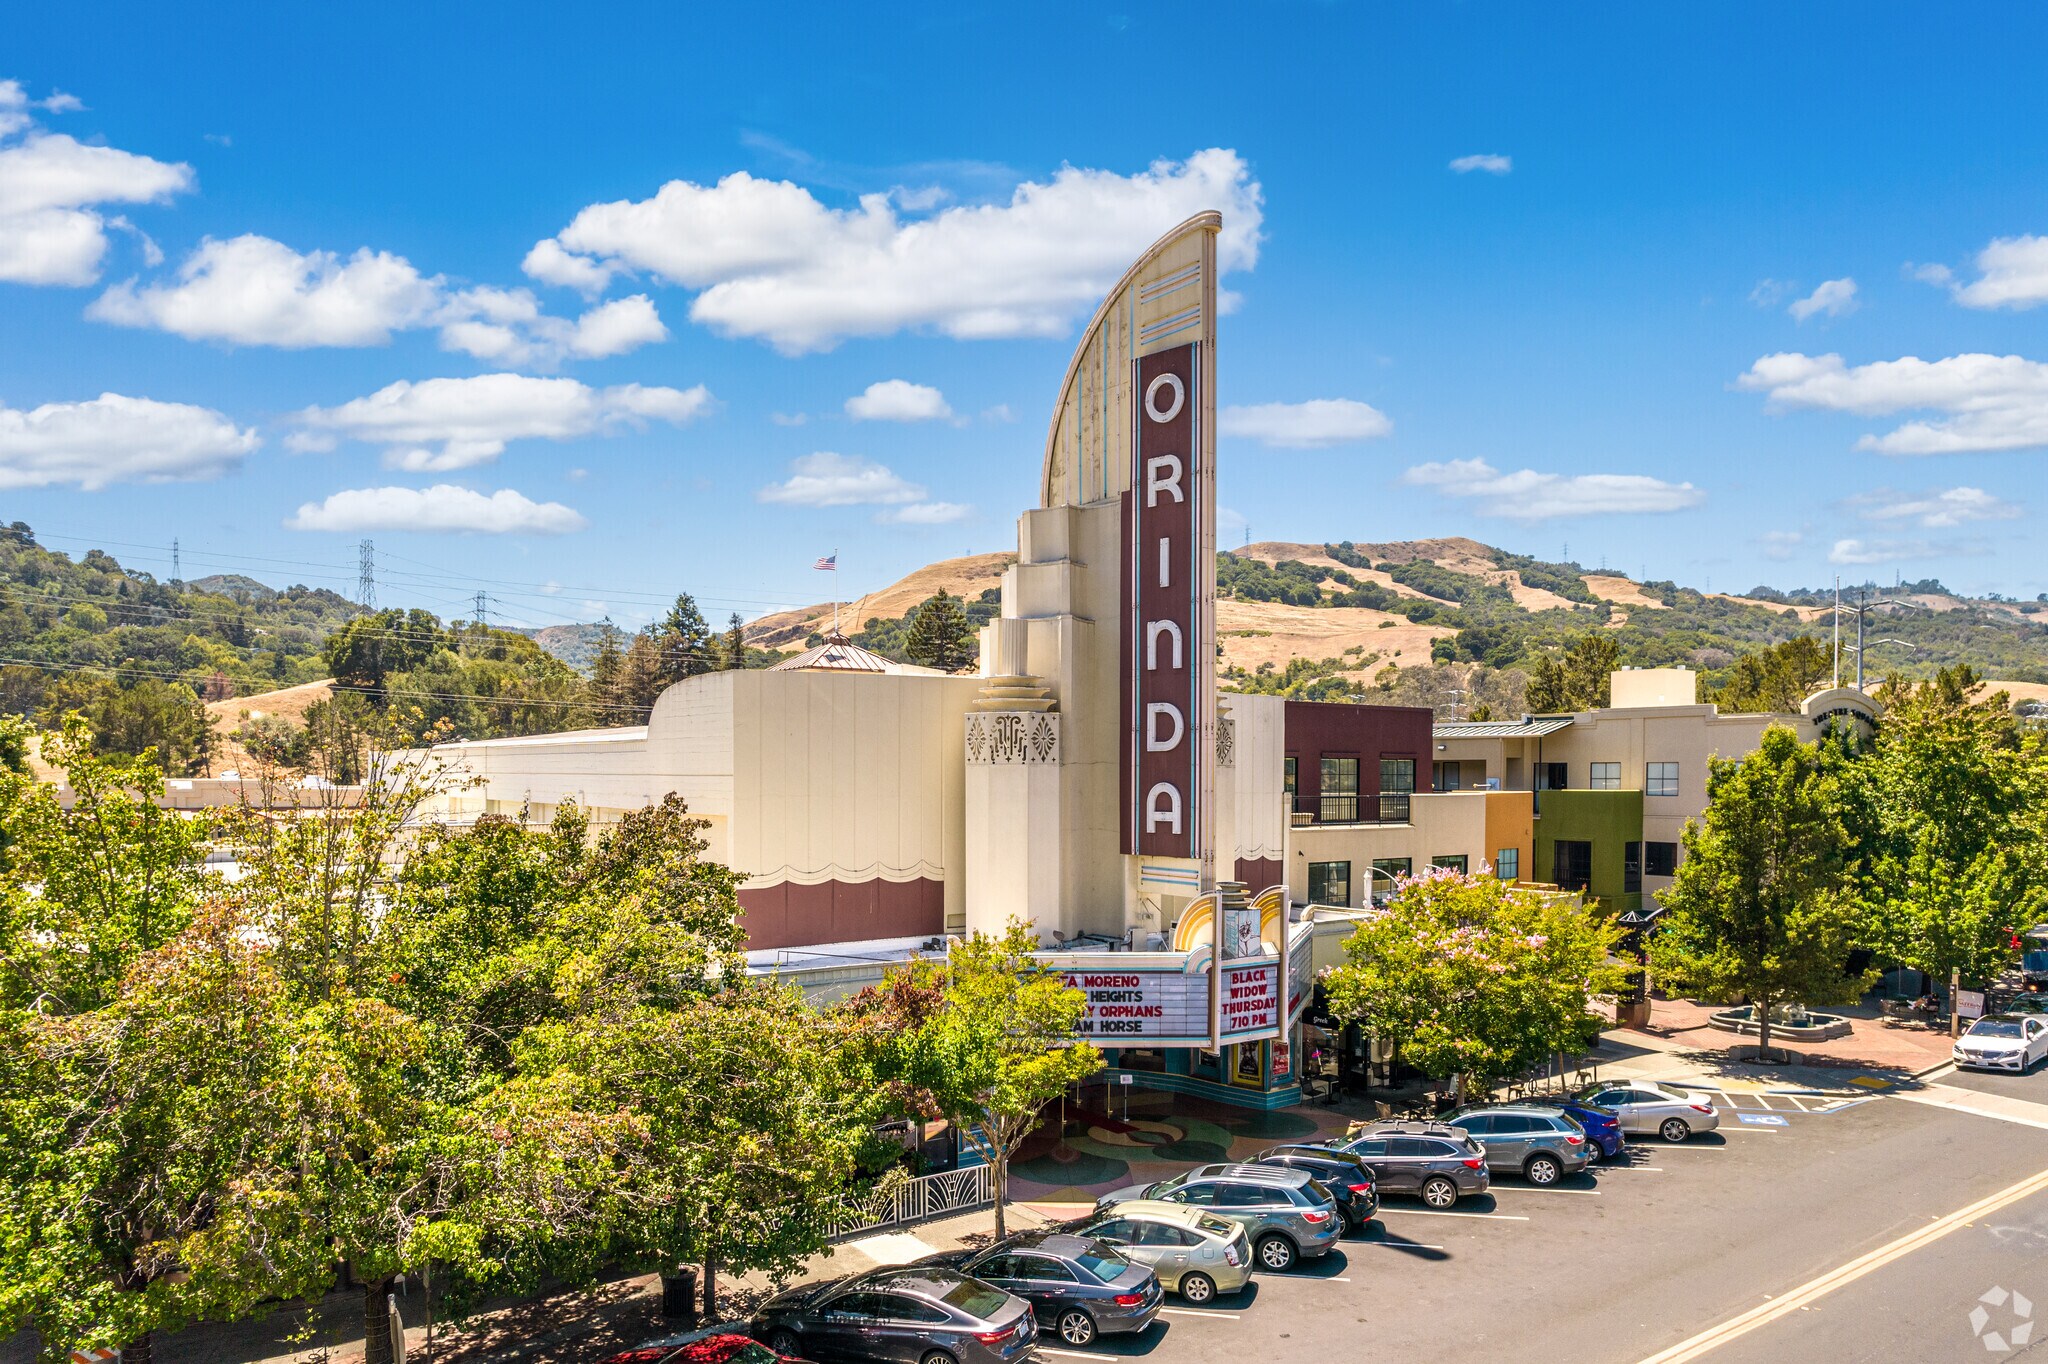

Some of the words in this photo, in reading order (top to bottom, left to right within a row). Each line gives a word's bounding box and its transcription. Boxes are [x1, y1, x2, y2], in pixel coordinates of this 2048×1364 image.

[1084, 975, 1140, 988] MORENO
[1232, 969, 1267, 985] BLACK
[1090, 990, 1143, 1003] HEIGHTS
[1230, 984, 1268, 999] WIDOW
[1099, 1005, 1163, 1018] ORPHANS
[1222, 997, 1276, 1015] THURSDAY
[1100, 1020, 1143, 1033] HORSE
[1231, 1016, 1249, 1029] 710
[1251, 1013, 1267, 1026] PM
